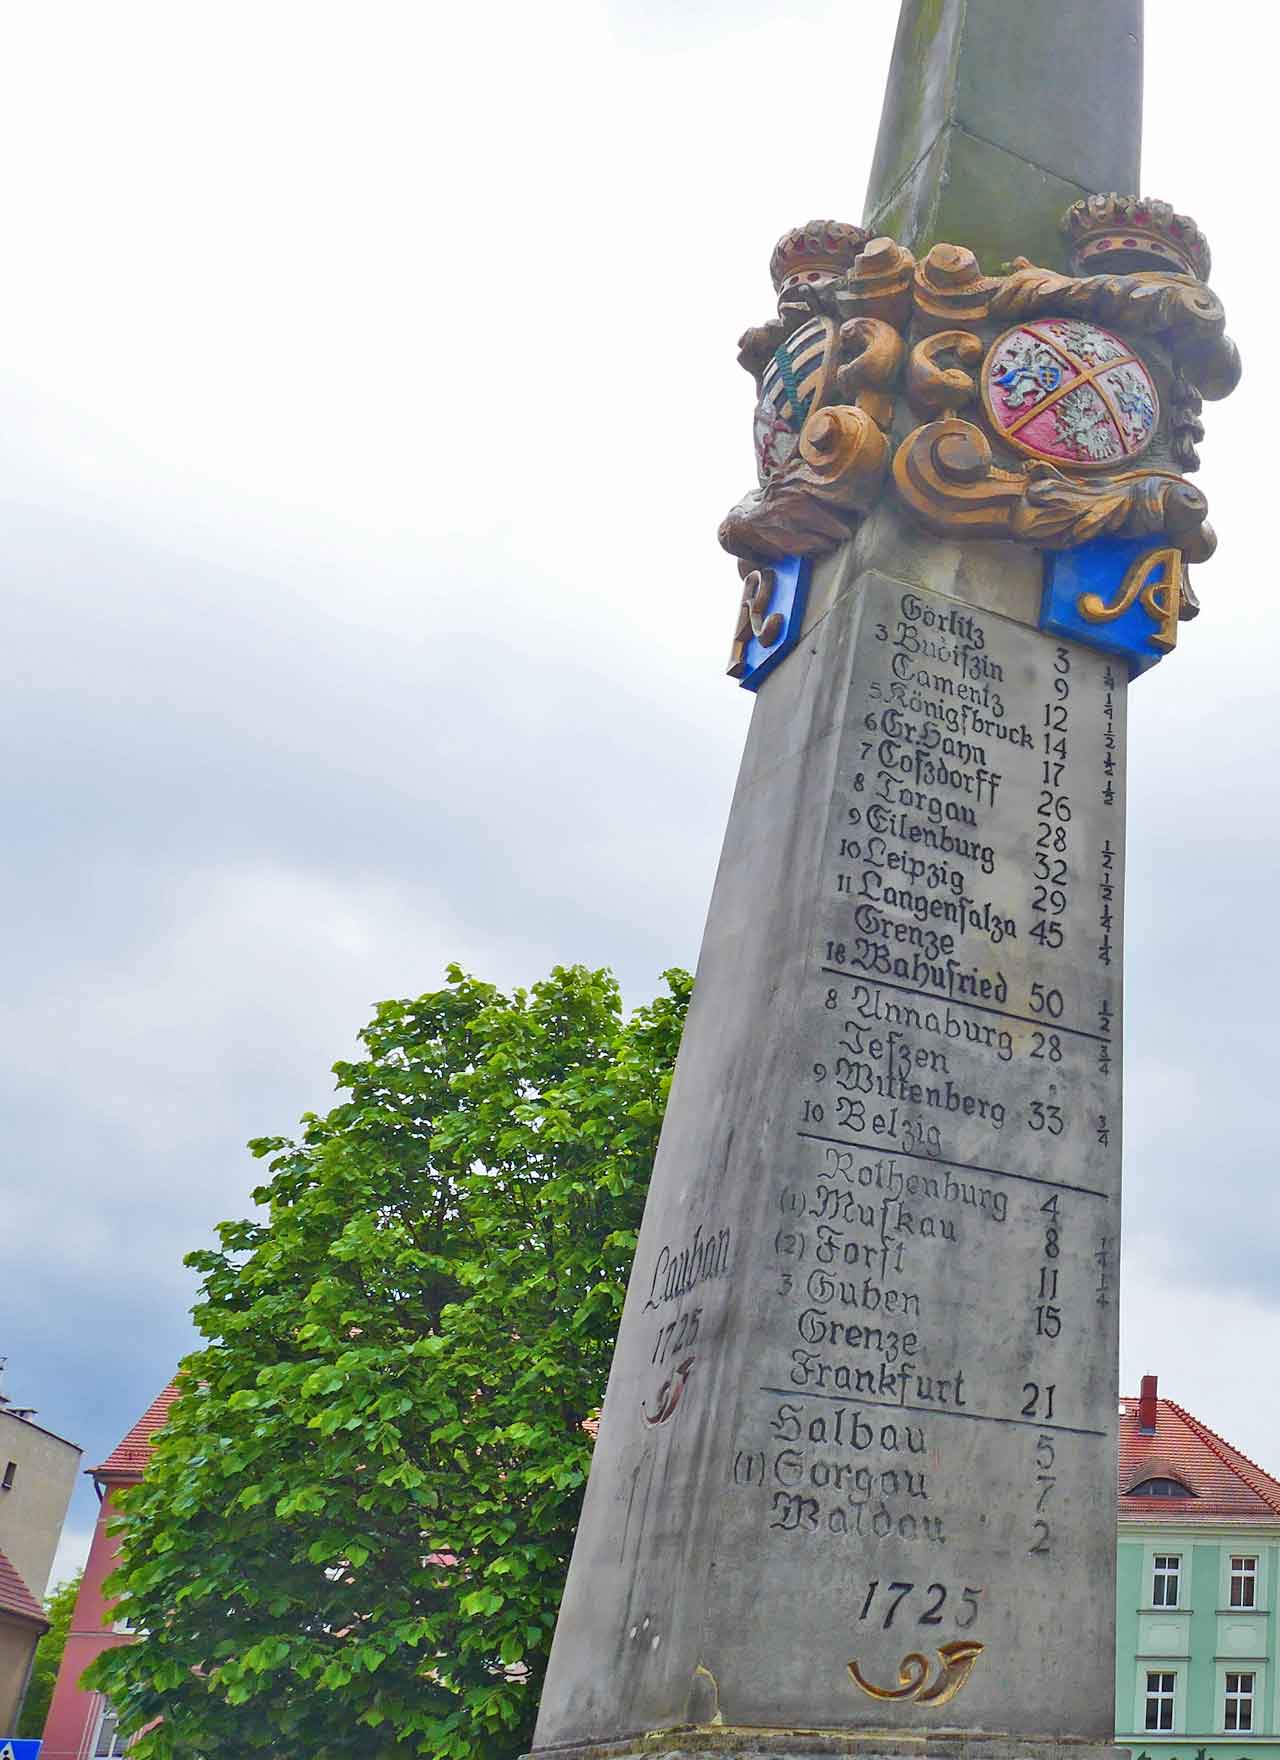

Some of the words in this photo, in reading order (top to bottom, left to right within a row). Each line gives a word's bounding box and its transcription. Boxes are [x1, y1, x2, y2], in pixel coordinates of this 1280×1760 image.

[874, 623, 889, 641] 3
[1054, 678, 1070, 701] 9
[1053, 648, 1071, 674] 3
[1043, 703, 1068, 732] 12
[1043, 732, 1067, 760] 14
[863, 712, 878, 731] 6
[1042, 760, 1065, 787] 17
[860, 742, 873, 760] 7
[1037, 790, 1072, 822] 26
[853, 772, 865, 792] 8
[1036, 822, 1067, 852] 28
[848, 807, 862, 825] 9
[866, 804, 995, 874] Eilenburg
[1032, 851, 1067, 886] 32
[863, 837, 965, 895] Leipzig
[1031, 885, 1067, 915] 29
[854, 903, 955, 961] Grenze
[1028, 919, 1064, 949] 45
[824, 988, 839, 1010] 8
[1029, 1031, 1063, 1063] 28
[1028, 981, 1064, 1018] 50
[802, 1099, 824, 1123] 10
[835, 1095, 943, 1157] Belzig
[812, 1062, 828, 1082] 9
[1028, 1101, 1064, 1136] 33
[817, 1148, 1009, 1222] Rothenburg
[1040, 1194, 1060, 1223] 4
[1044, 1227, 1060, 1259] 8
[807, 1268, 922, 1317] Guben
[1034, 1304, 1062, 1339] 15
[1037, 1266, 1059, 1301] 11
[798, 1308, 919, 1364] Grenze
[790, 1348, 967, 1407] Frankfurt
[1020, 1382, 1057, 1420] 21
[1036, 1434, 1055, 1469] 5
[1036, 1474, 1057, 1513] 7
[1029, 1519, 1050, 1552] 2
[858, 1580, 984, 1630] 1725
